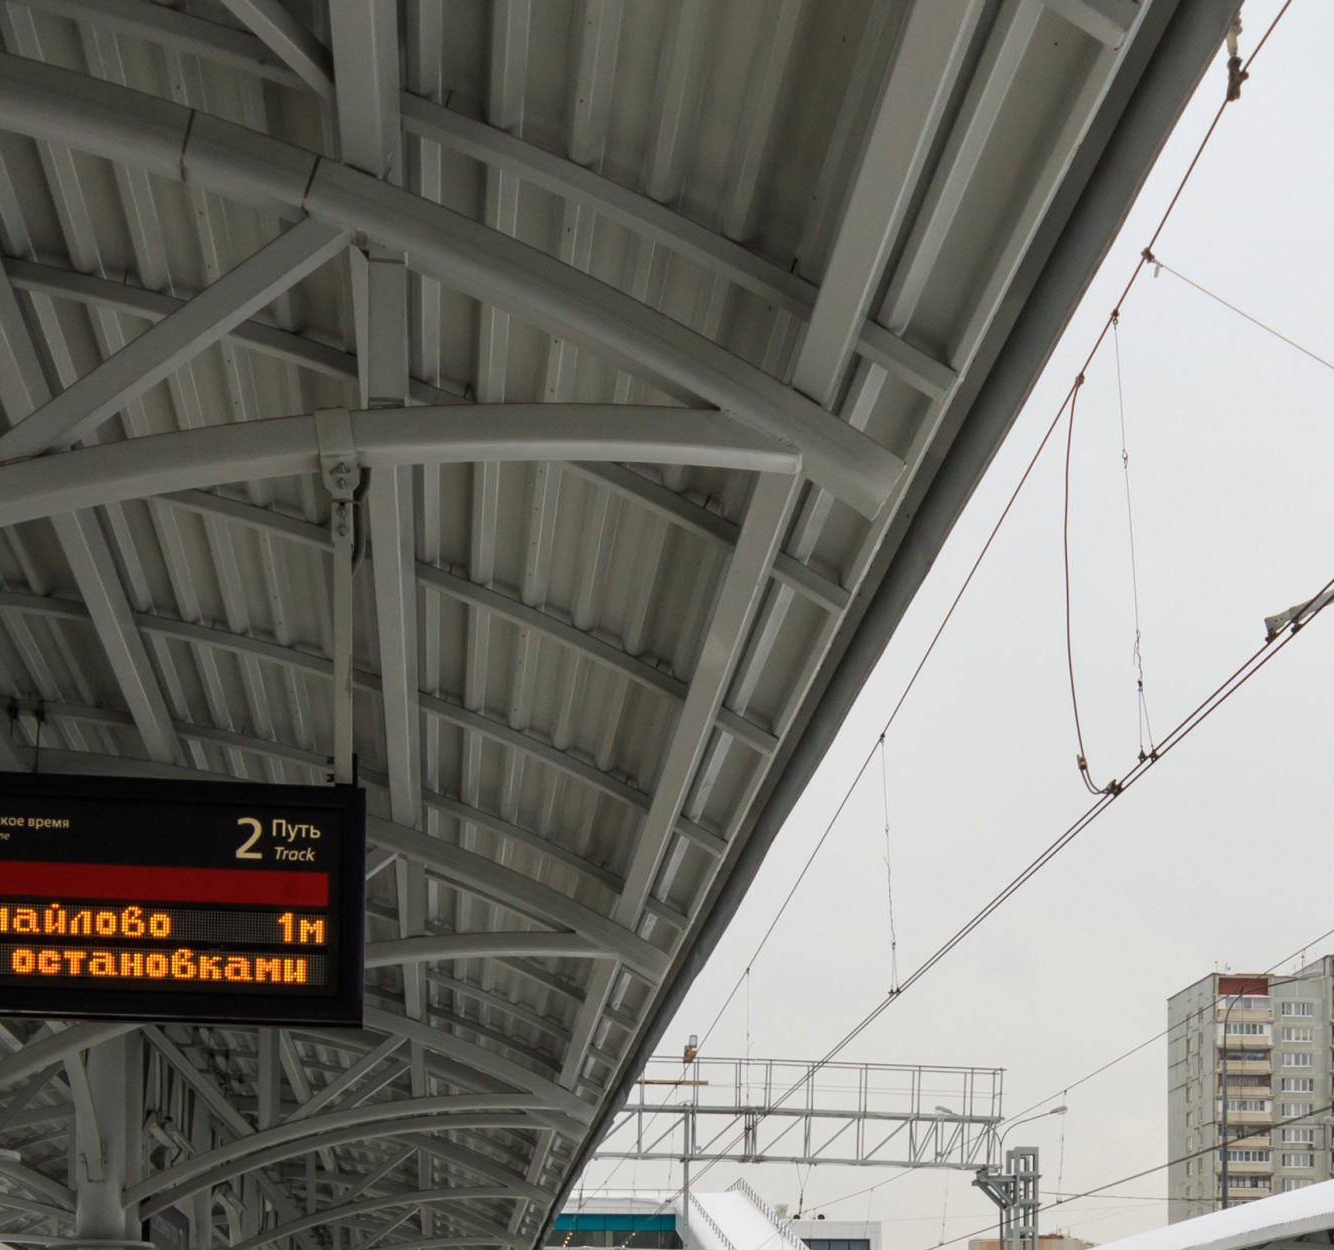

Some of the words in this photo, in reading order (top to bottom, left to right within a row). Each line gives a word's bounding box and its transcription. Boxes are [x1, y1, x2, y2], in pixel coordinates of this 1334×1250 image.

[28, 817, 69, 829] время
[272, 819, 321, 842] Путь
[235, 817, 263, 860] 2
[274, 847, 315, 862] Track
[278, 913, 324, 943] 1м
[12, 949, 307, 984] остановками
